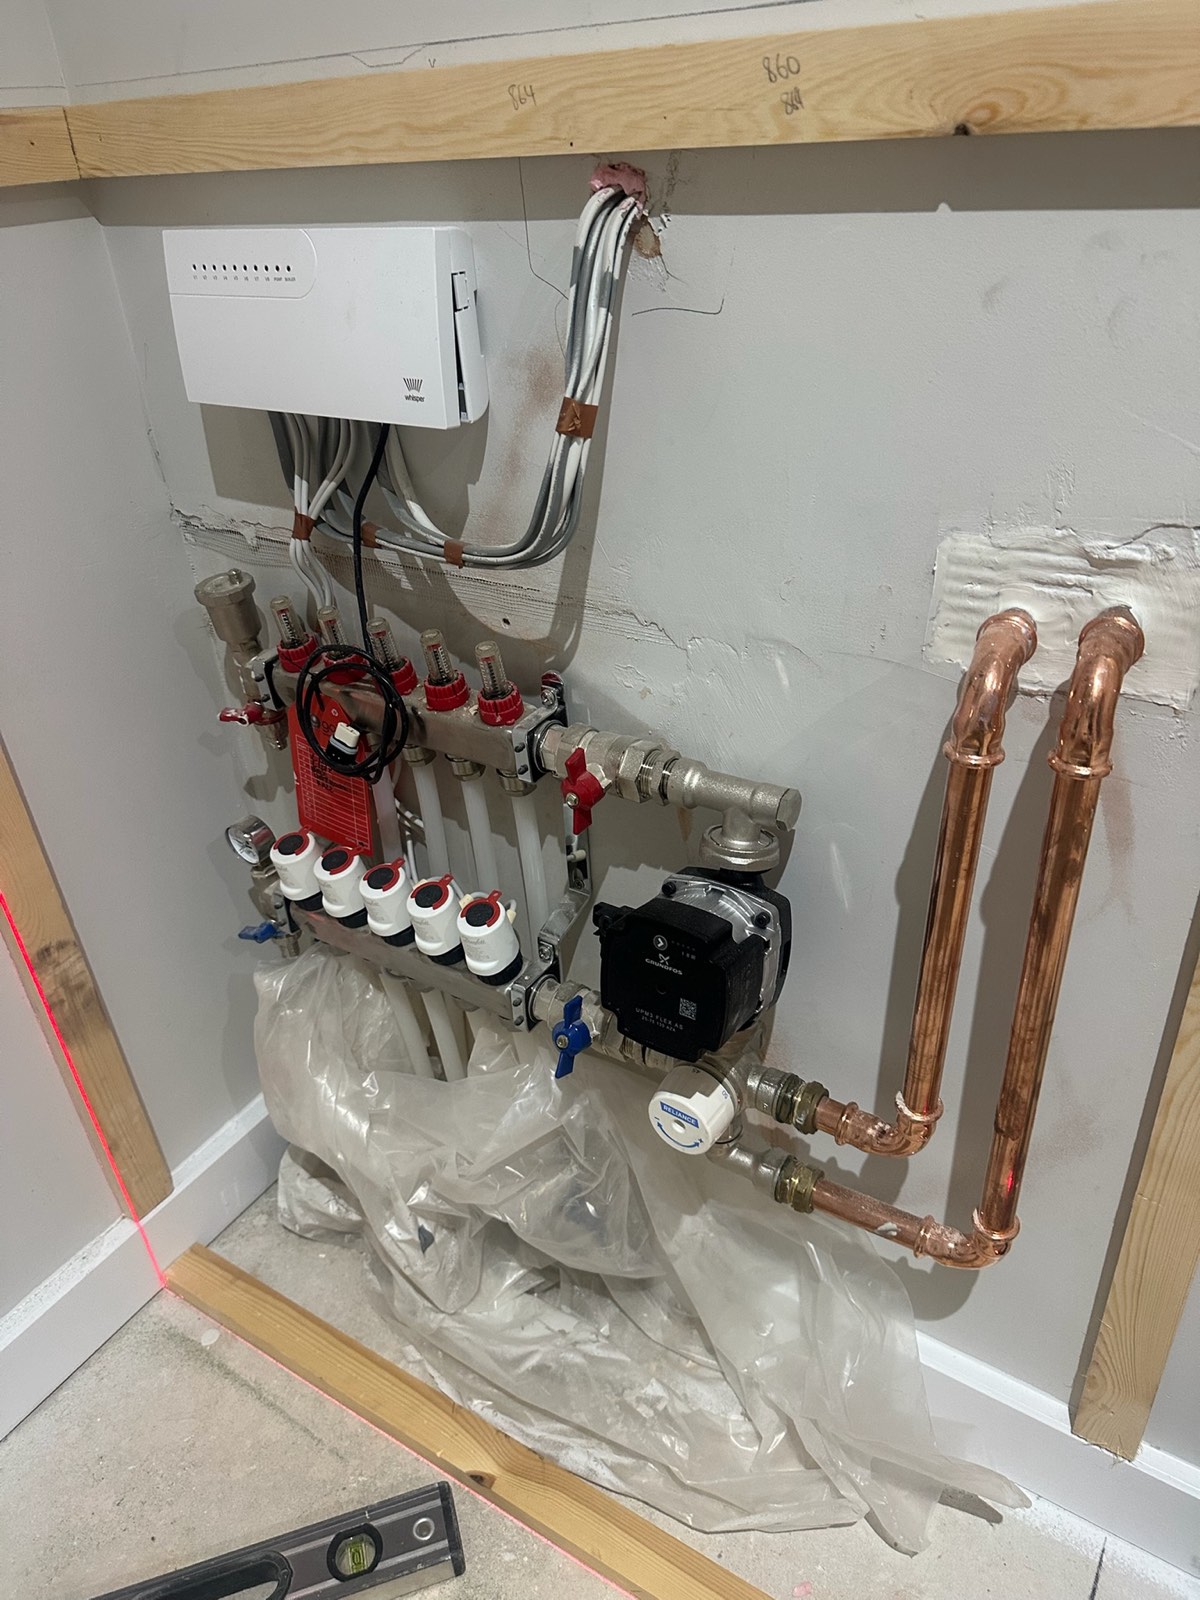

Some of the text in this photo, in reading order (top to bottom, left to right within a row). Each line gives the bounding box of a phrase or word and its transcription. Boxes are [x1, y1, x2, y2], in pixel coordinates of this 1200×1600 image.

[762, 53, 801, 83] 860
[508, 84, 537, 111] 864
[404, 394, 425, 403] whisper
[645, 958, 683, 975] GRUNDFOS
[663, 1104, 698, 1126] RELIANCE
